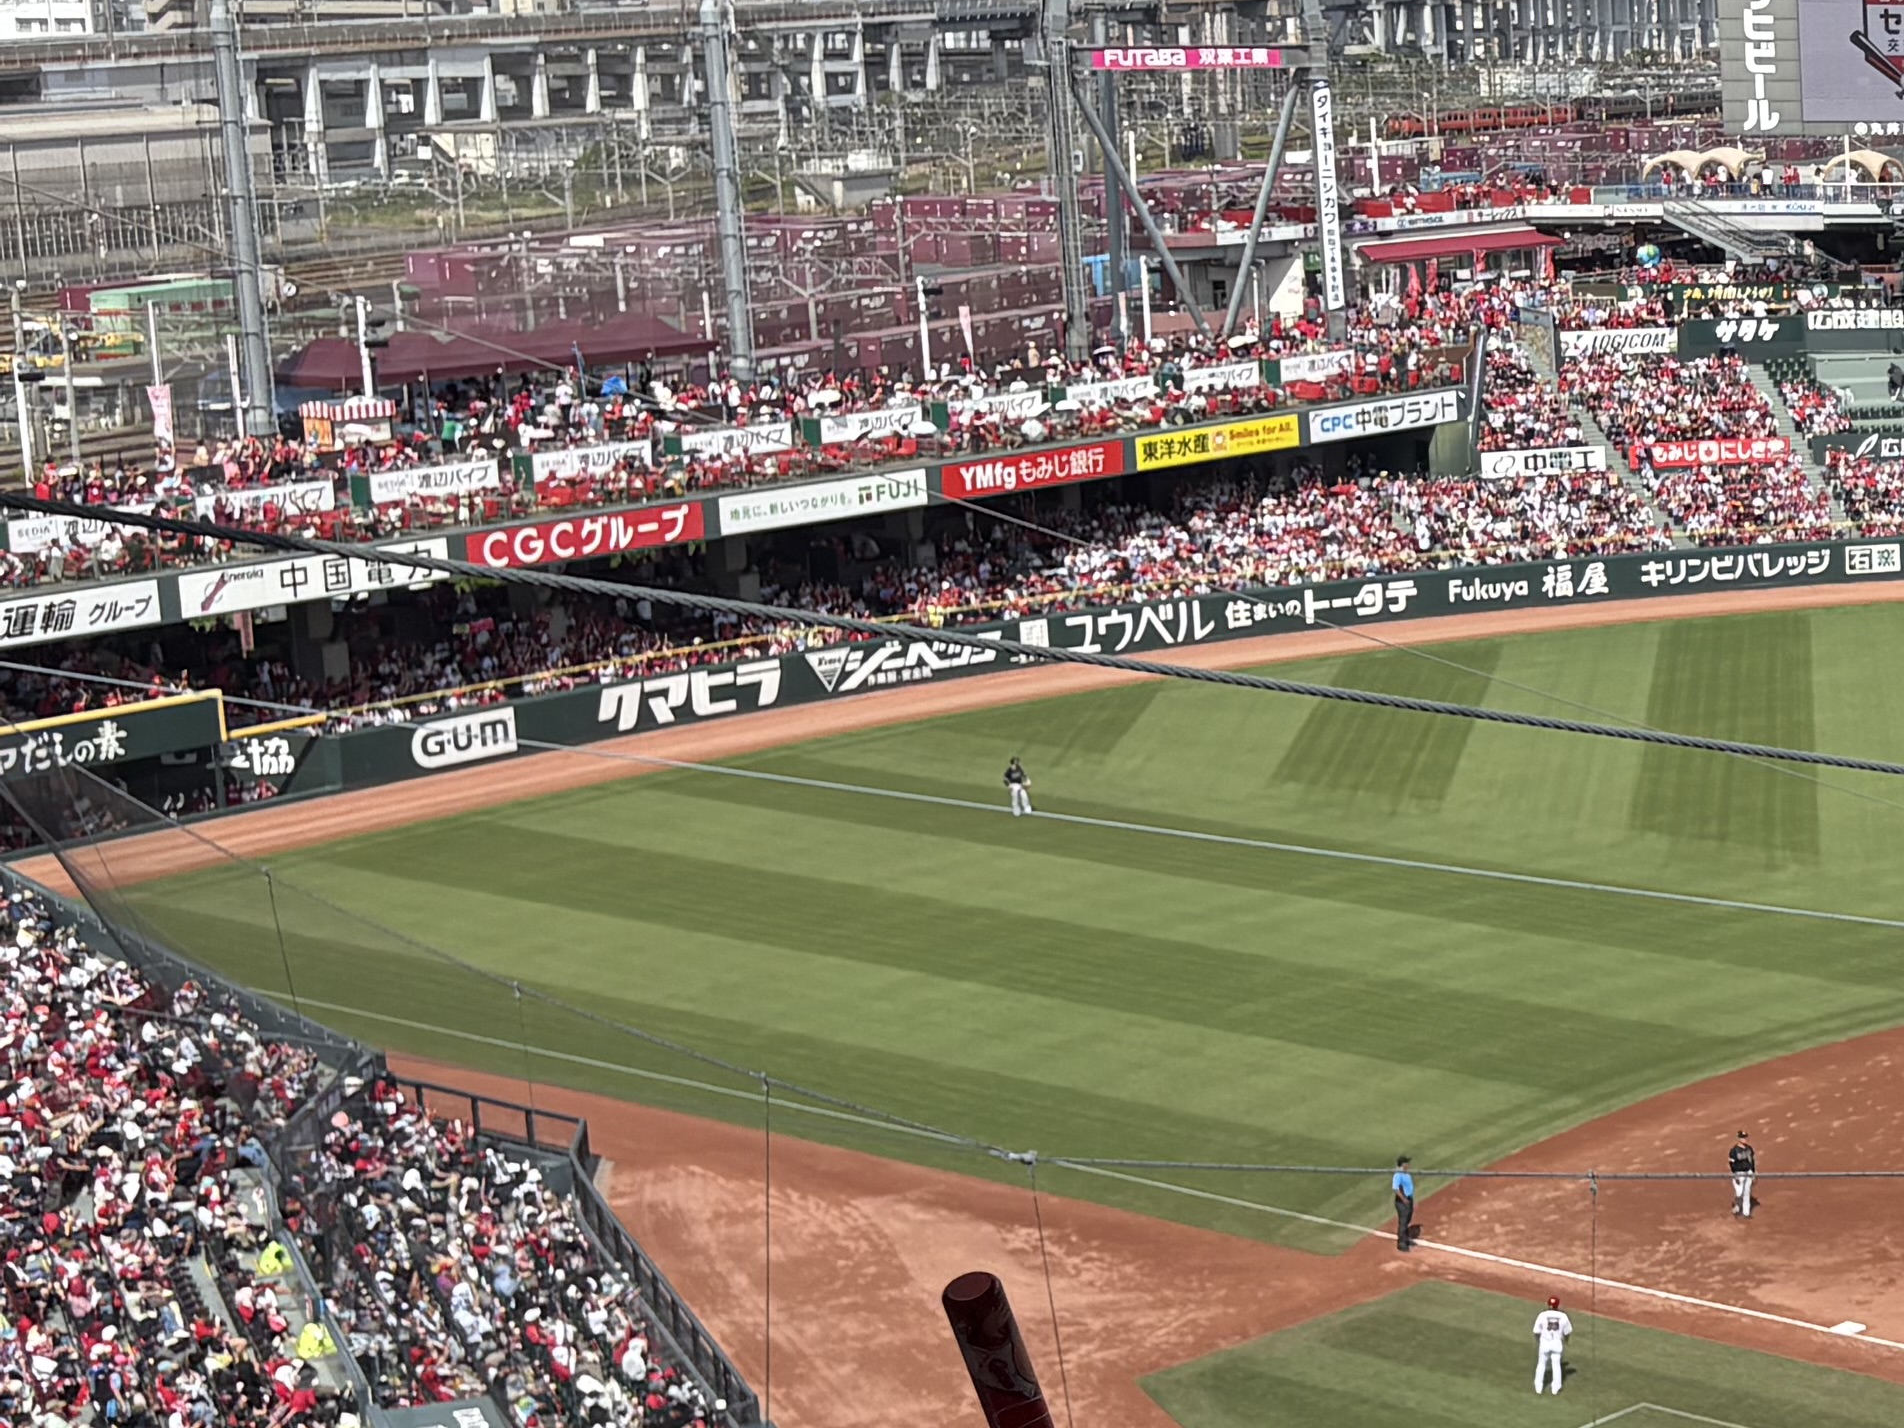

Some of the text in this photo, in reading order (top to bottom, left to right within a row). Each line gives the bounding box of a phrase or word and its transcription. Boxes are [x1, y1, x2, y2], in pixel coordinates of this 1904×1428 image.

[1715, 318, 1779, 343] サタケ
[1142, 431, 1210, 463] 東洋水産
[876, 477, 921, 503] FUJI
[960, 446, 1106, 495] YMfg もみじ銀行
[482, 504, 690, 568] CGCグループ
[1447, 563, 1610, 604] Fukuya 福屋
[1639, 546, 1831, 588] キリンビバレッジ
[88, 594, 153, 627] グループ
[1225, 580, 1419, 630] 住まいの トータテ
[1065, 599, 1216, 654] ユウベル
[597, 657, 783, 733] クマヒラ
